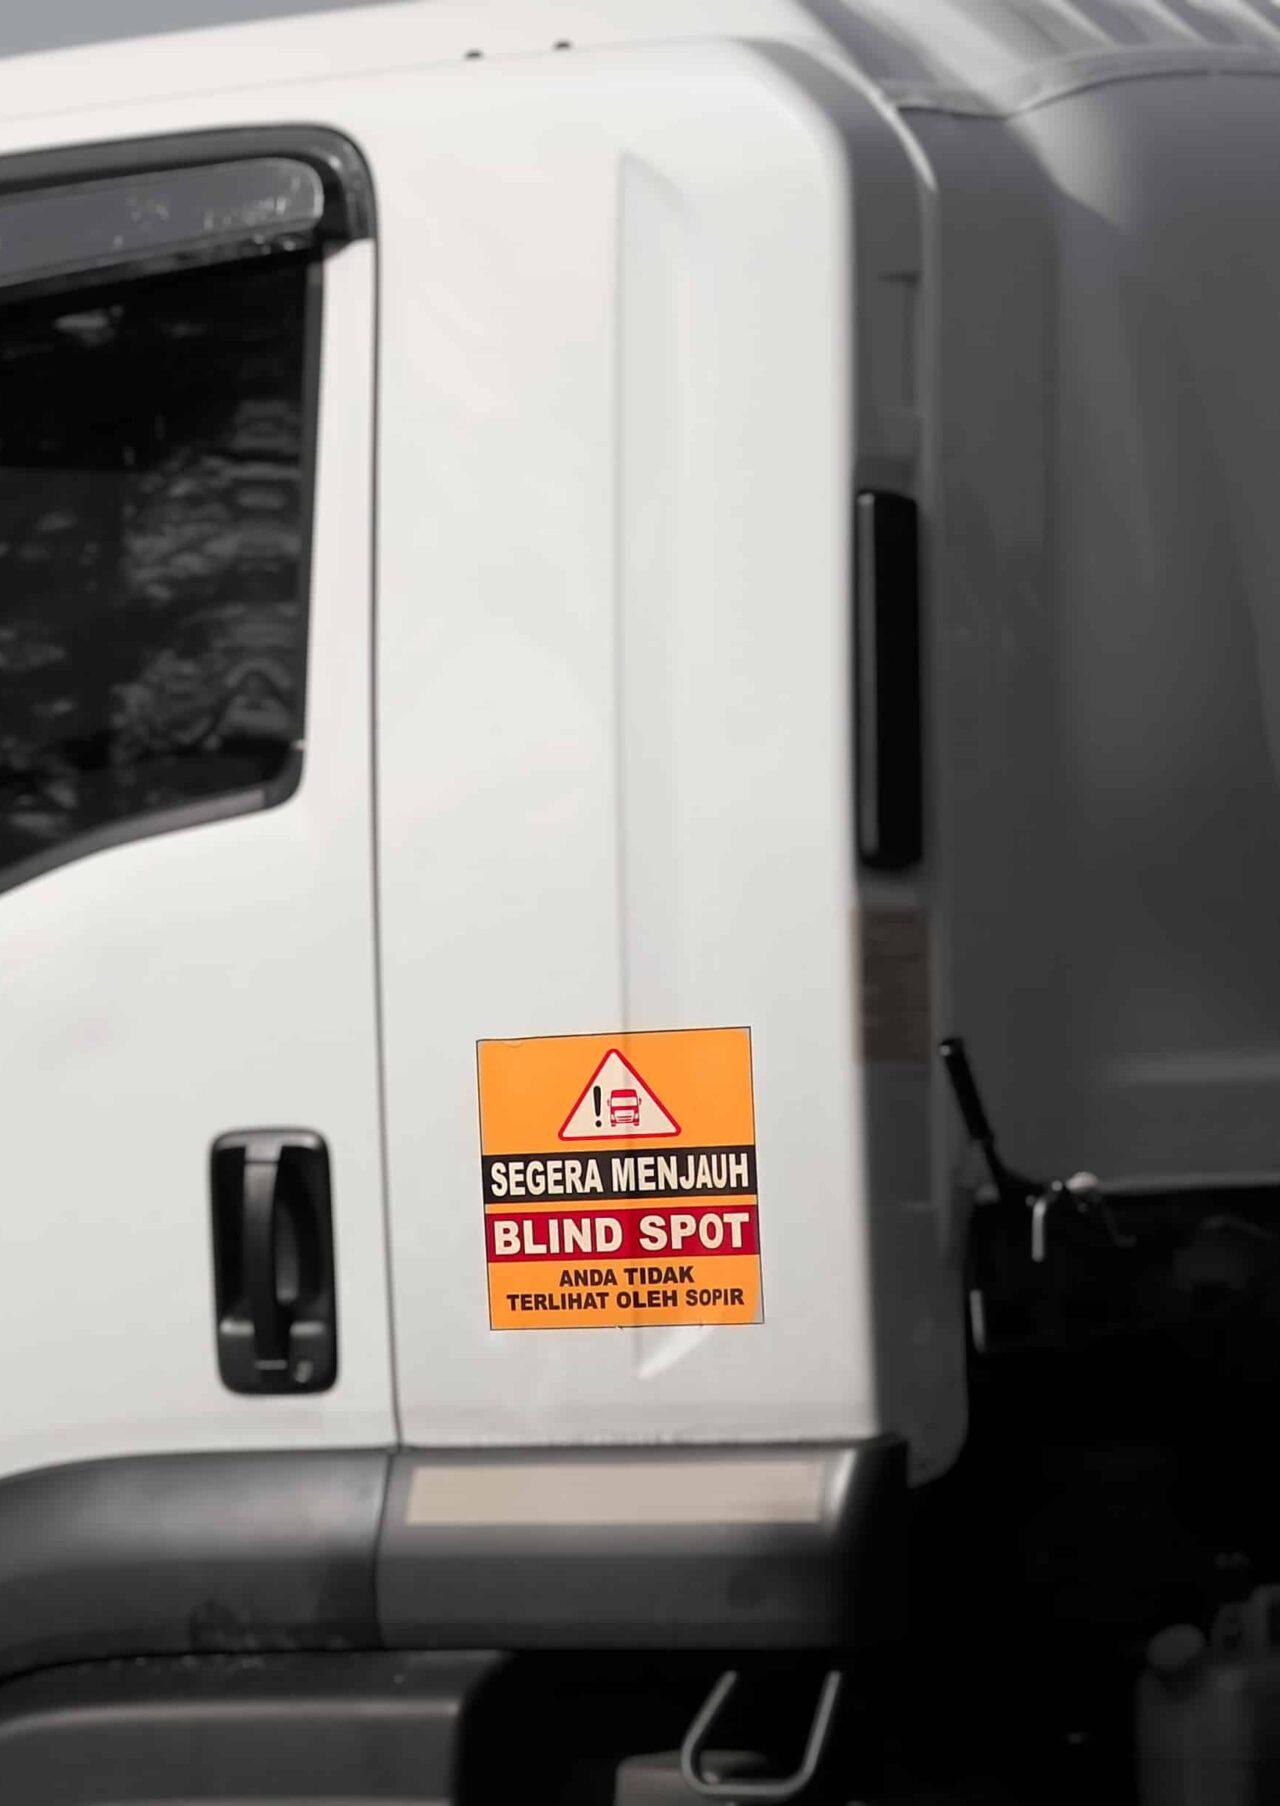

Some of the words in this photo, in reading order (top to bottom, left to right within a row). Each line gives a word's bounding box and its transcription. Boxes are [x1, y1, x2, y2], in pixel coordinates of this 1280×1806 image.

[491, 1158, 604, 1197] SEGERA
[611, 1153, 749, 1192] MENJAUH
[493, 1217, 623, 1256] BLIND
[639, 1212, 750, 1251] SPOT
[559, 1269, 618, 1287] ANDA
[623, 1265, 695, 1285] TIDAK
[506, 1292, 610, 1311] TERLIHAT
[616, 1289, 679, 1309] OLEH
[685, 1288, 745, 1306] SOPIR
